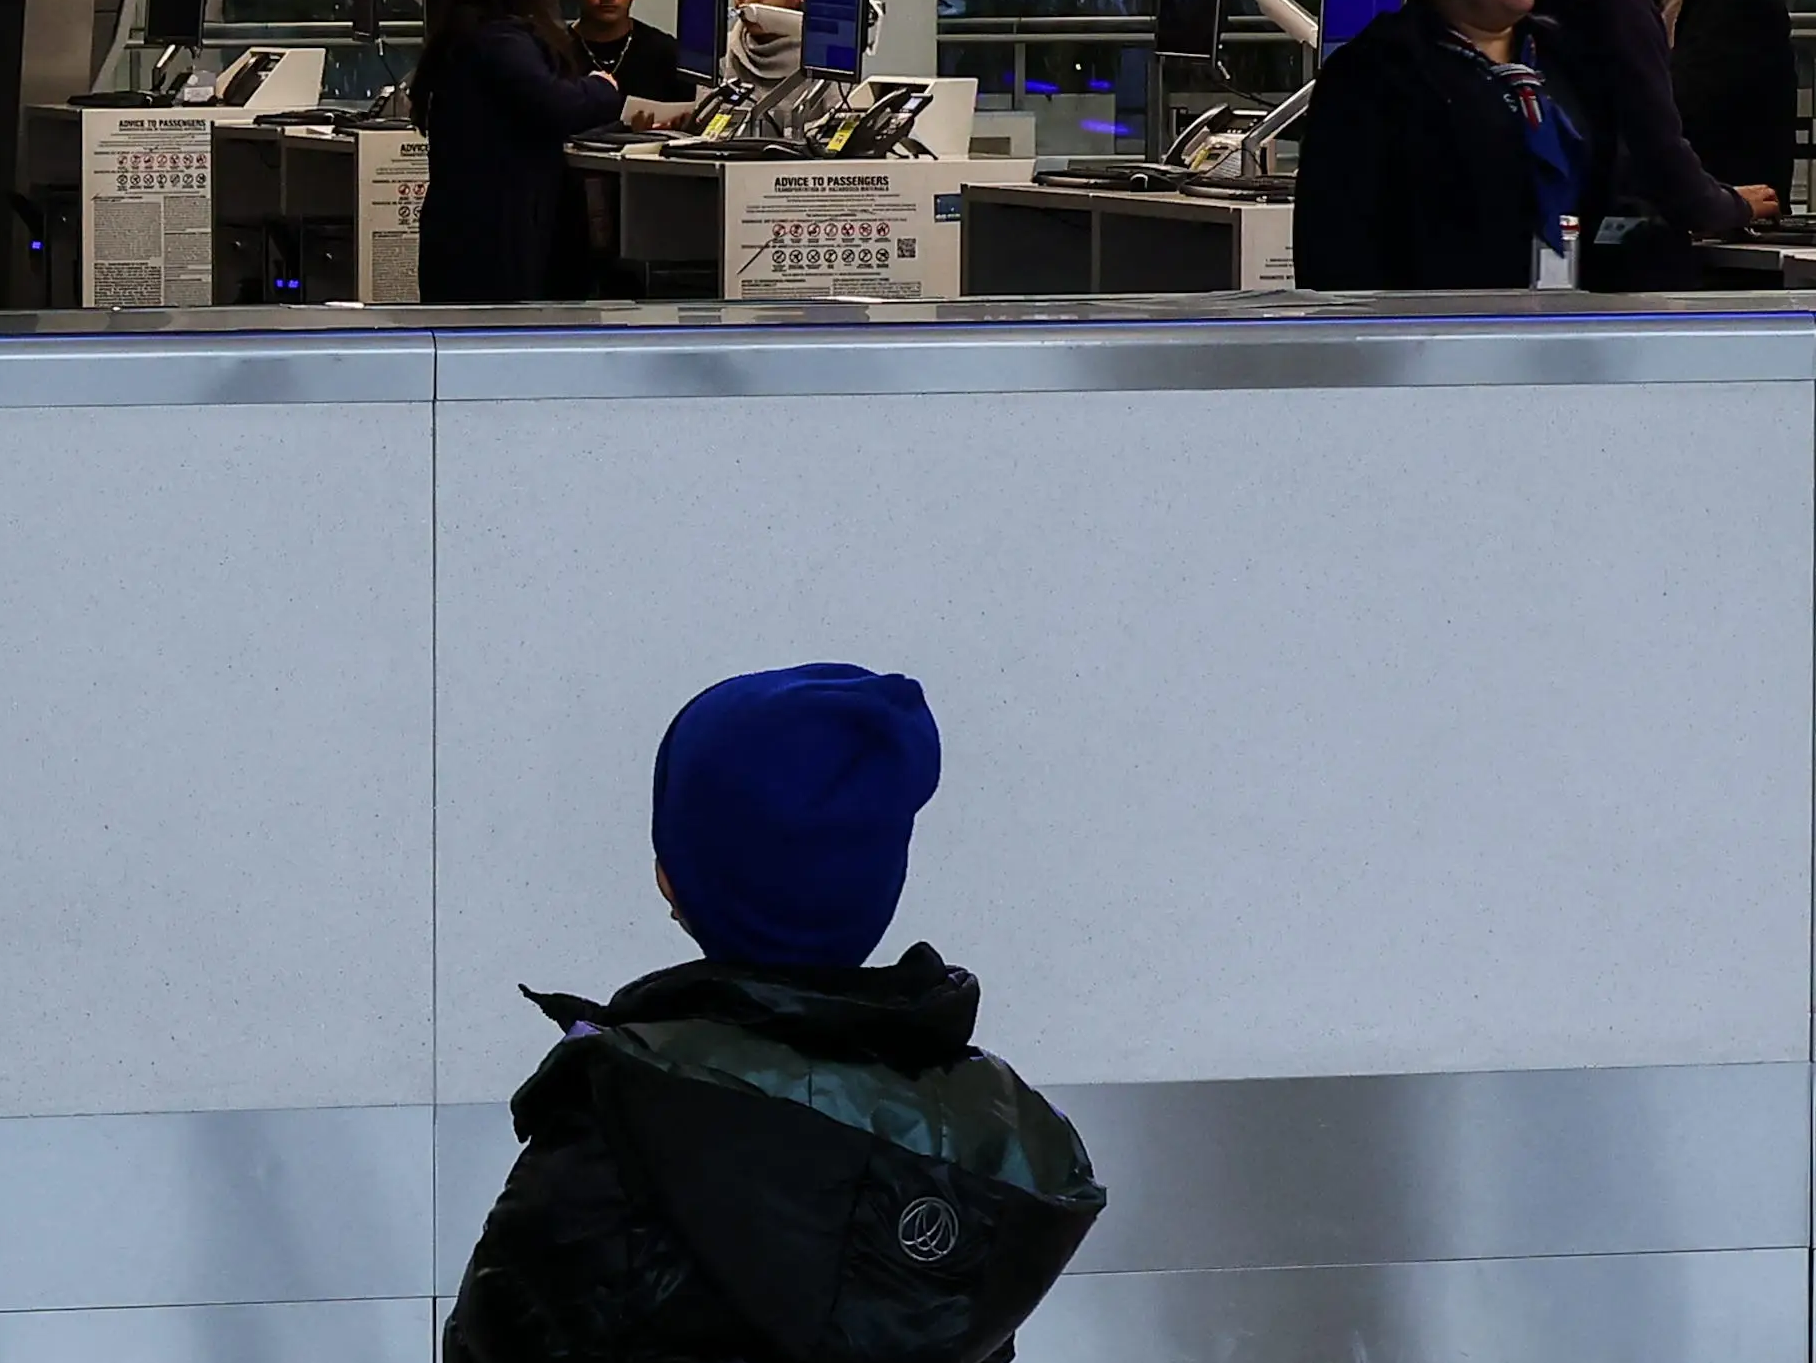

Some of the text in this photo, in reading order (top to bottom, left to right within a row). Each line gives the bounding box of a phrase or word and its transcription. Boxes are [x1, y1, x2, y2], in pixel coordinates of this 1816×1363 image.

[119, 119, 148, 128] ADVICE
[159, 119, 206, 128] PASSENGERS
[775, 177, 889, 187] ADVICE TO PASSENGERS
